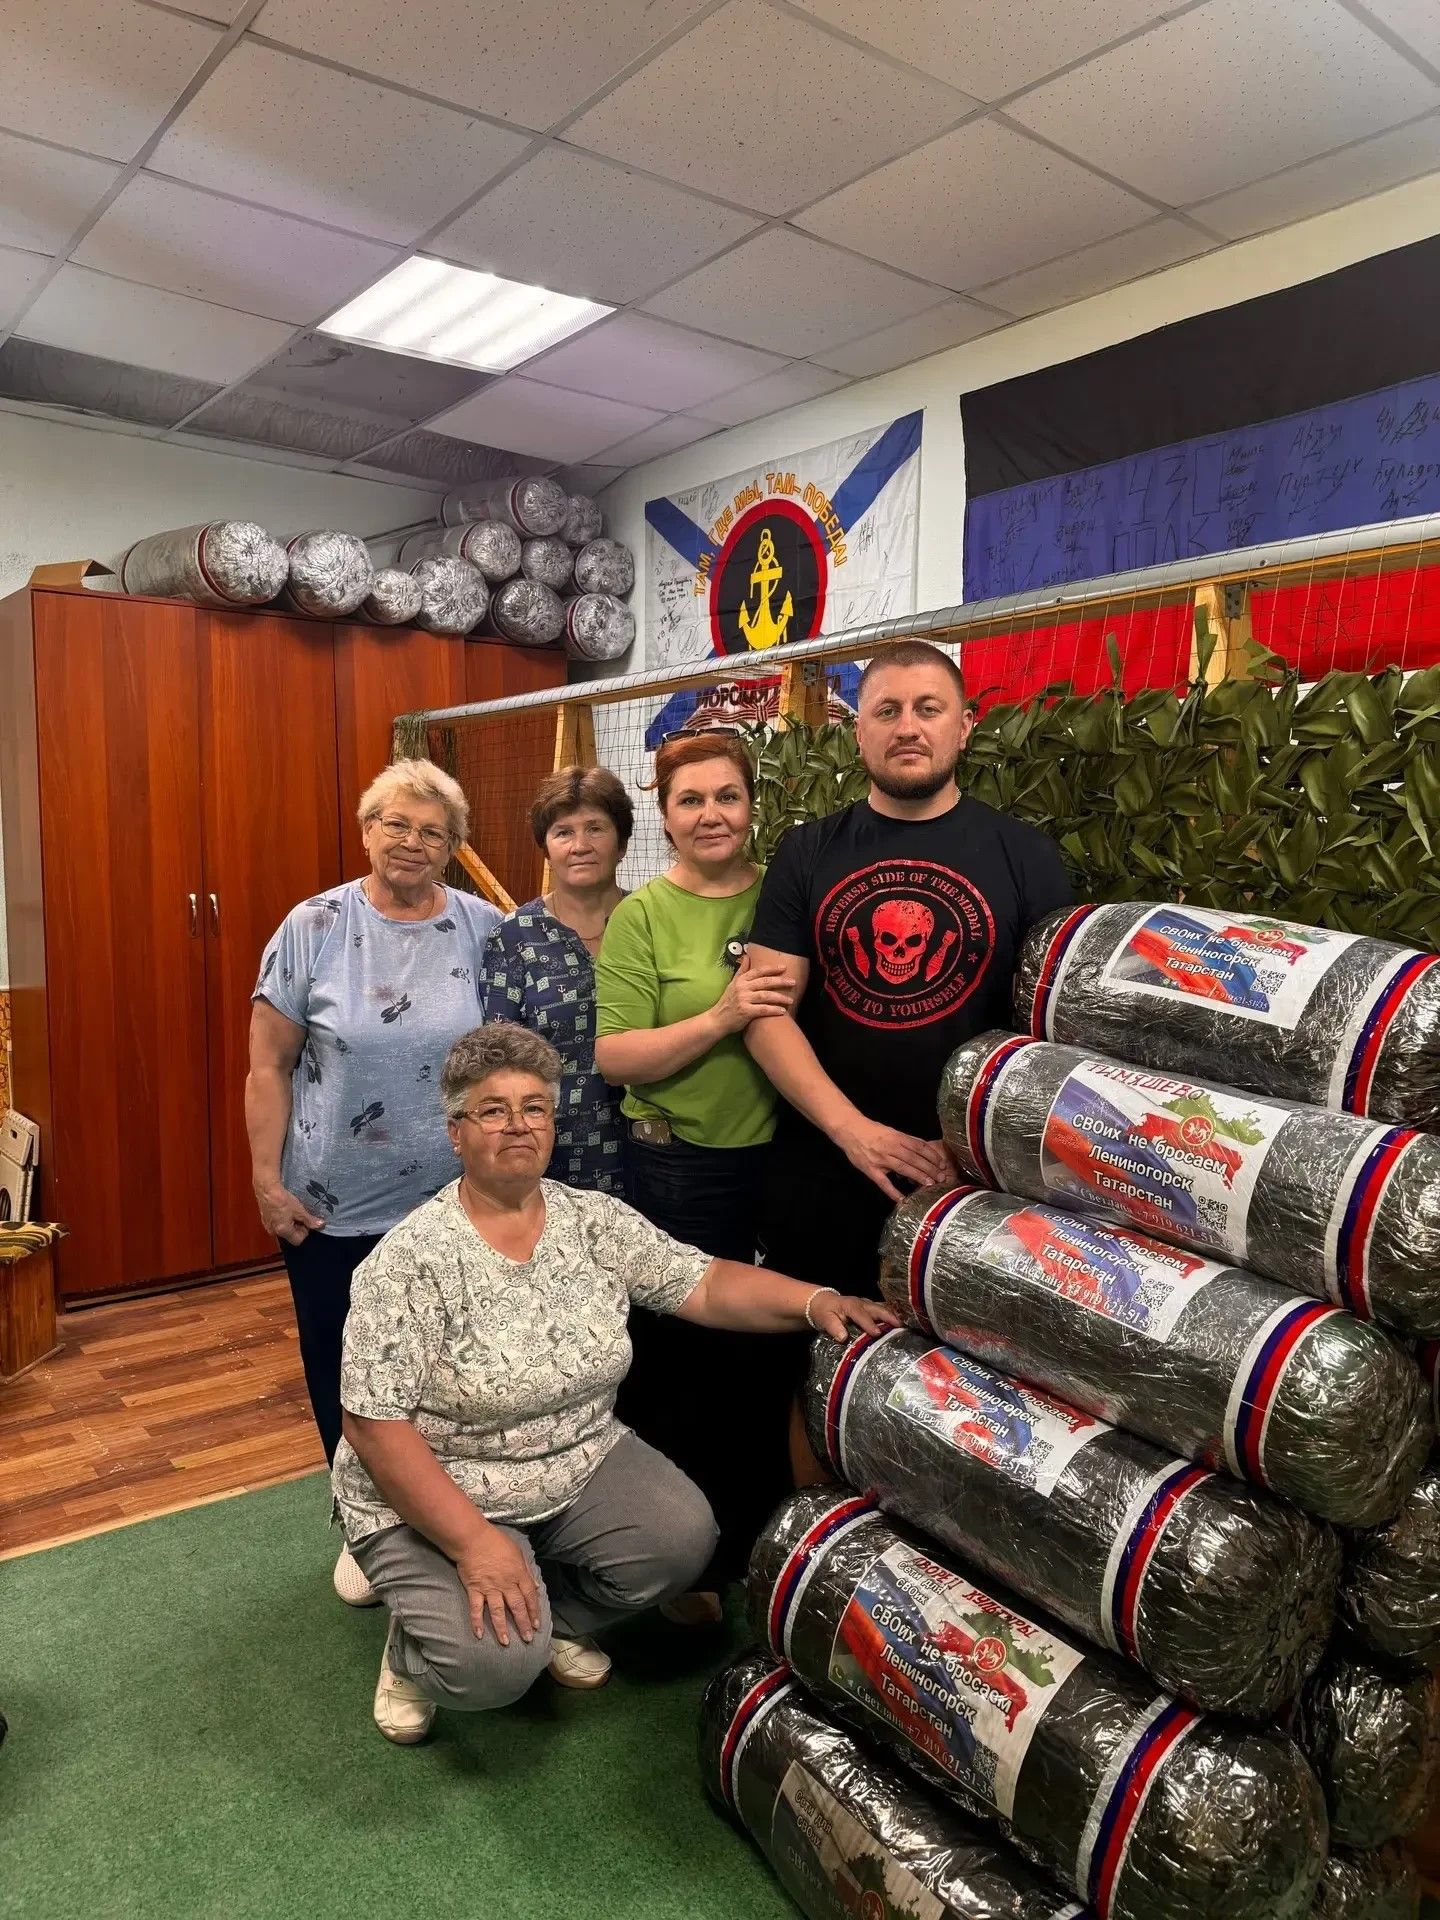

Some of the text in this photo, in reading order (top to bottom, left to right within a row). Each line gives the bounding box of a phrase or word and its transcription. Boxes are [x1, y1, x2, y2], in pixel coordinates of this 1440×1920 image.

[708, 505, 734, 546] ГДЕ
[734, 480, 763, 513] МЫ,
[803, 482, 848, 568] ПОБЕДА!
[826, 872, 983, 941] REVERSE SIDE OF THE MEDAL
[1168, 941, 1260, 968] Лениногорск
[1208, 933, 1223, 947] не
[1231, 936, 1293, 958] бросаем
[1164, 957, 1235, 981] Татарстан
[863, 1000, 884, 1015] TO
[889, 973, 966, 1017] YOURSELF
[1087, 1062, 1205, 1100] ТЫМЯШЕВО
[1089, 1144, 1194, 1192] Лениногорск
[1129, 1133, 1148, 1149] не
[1154, 1138, 1228, 1175] бросаем
[1093, 1170, 1173, 1210] Татарстан
[1152, 1214, 1173, 1228] 919
[1042, 1244, 1117, 1286] Татарстан
[1047, 1227, 1150, 1275] Лениногорск
[1094, 1229, 1113, 1242] не
[1121, 1237, 1188, 1271] бросаем
[952, 1376, 1041, 1426] Лениногорск
[996, 1380, 1015, 1391] не
[1019, 1389, 1080, 1425] бросаем
[921, 1578, 947, 1595] для
[880, 1642, 977, 1725] Лениногорск
[921, 1642, 941, 1662] не
[946, 1657, 1012, 1714] бросаем
[881, 1672, 953, 1739] Татарстан
[907, 1724, 920, 1740] +7
[923, 1733, 940, 1755] 919
[942, 1751, 994, 1798] 621-51-35
